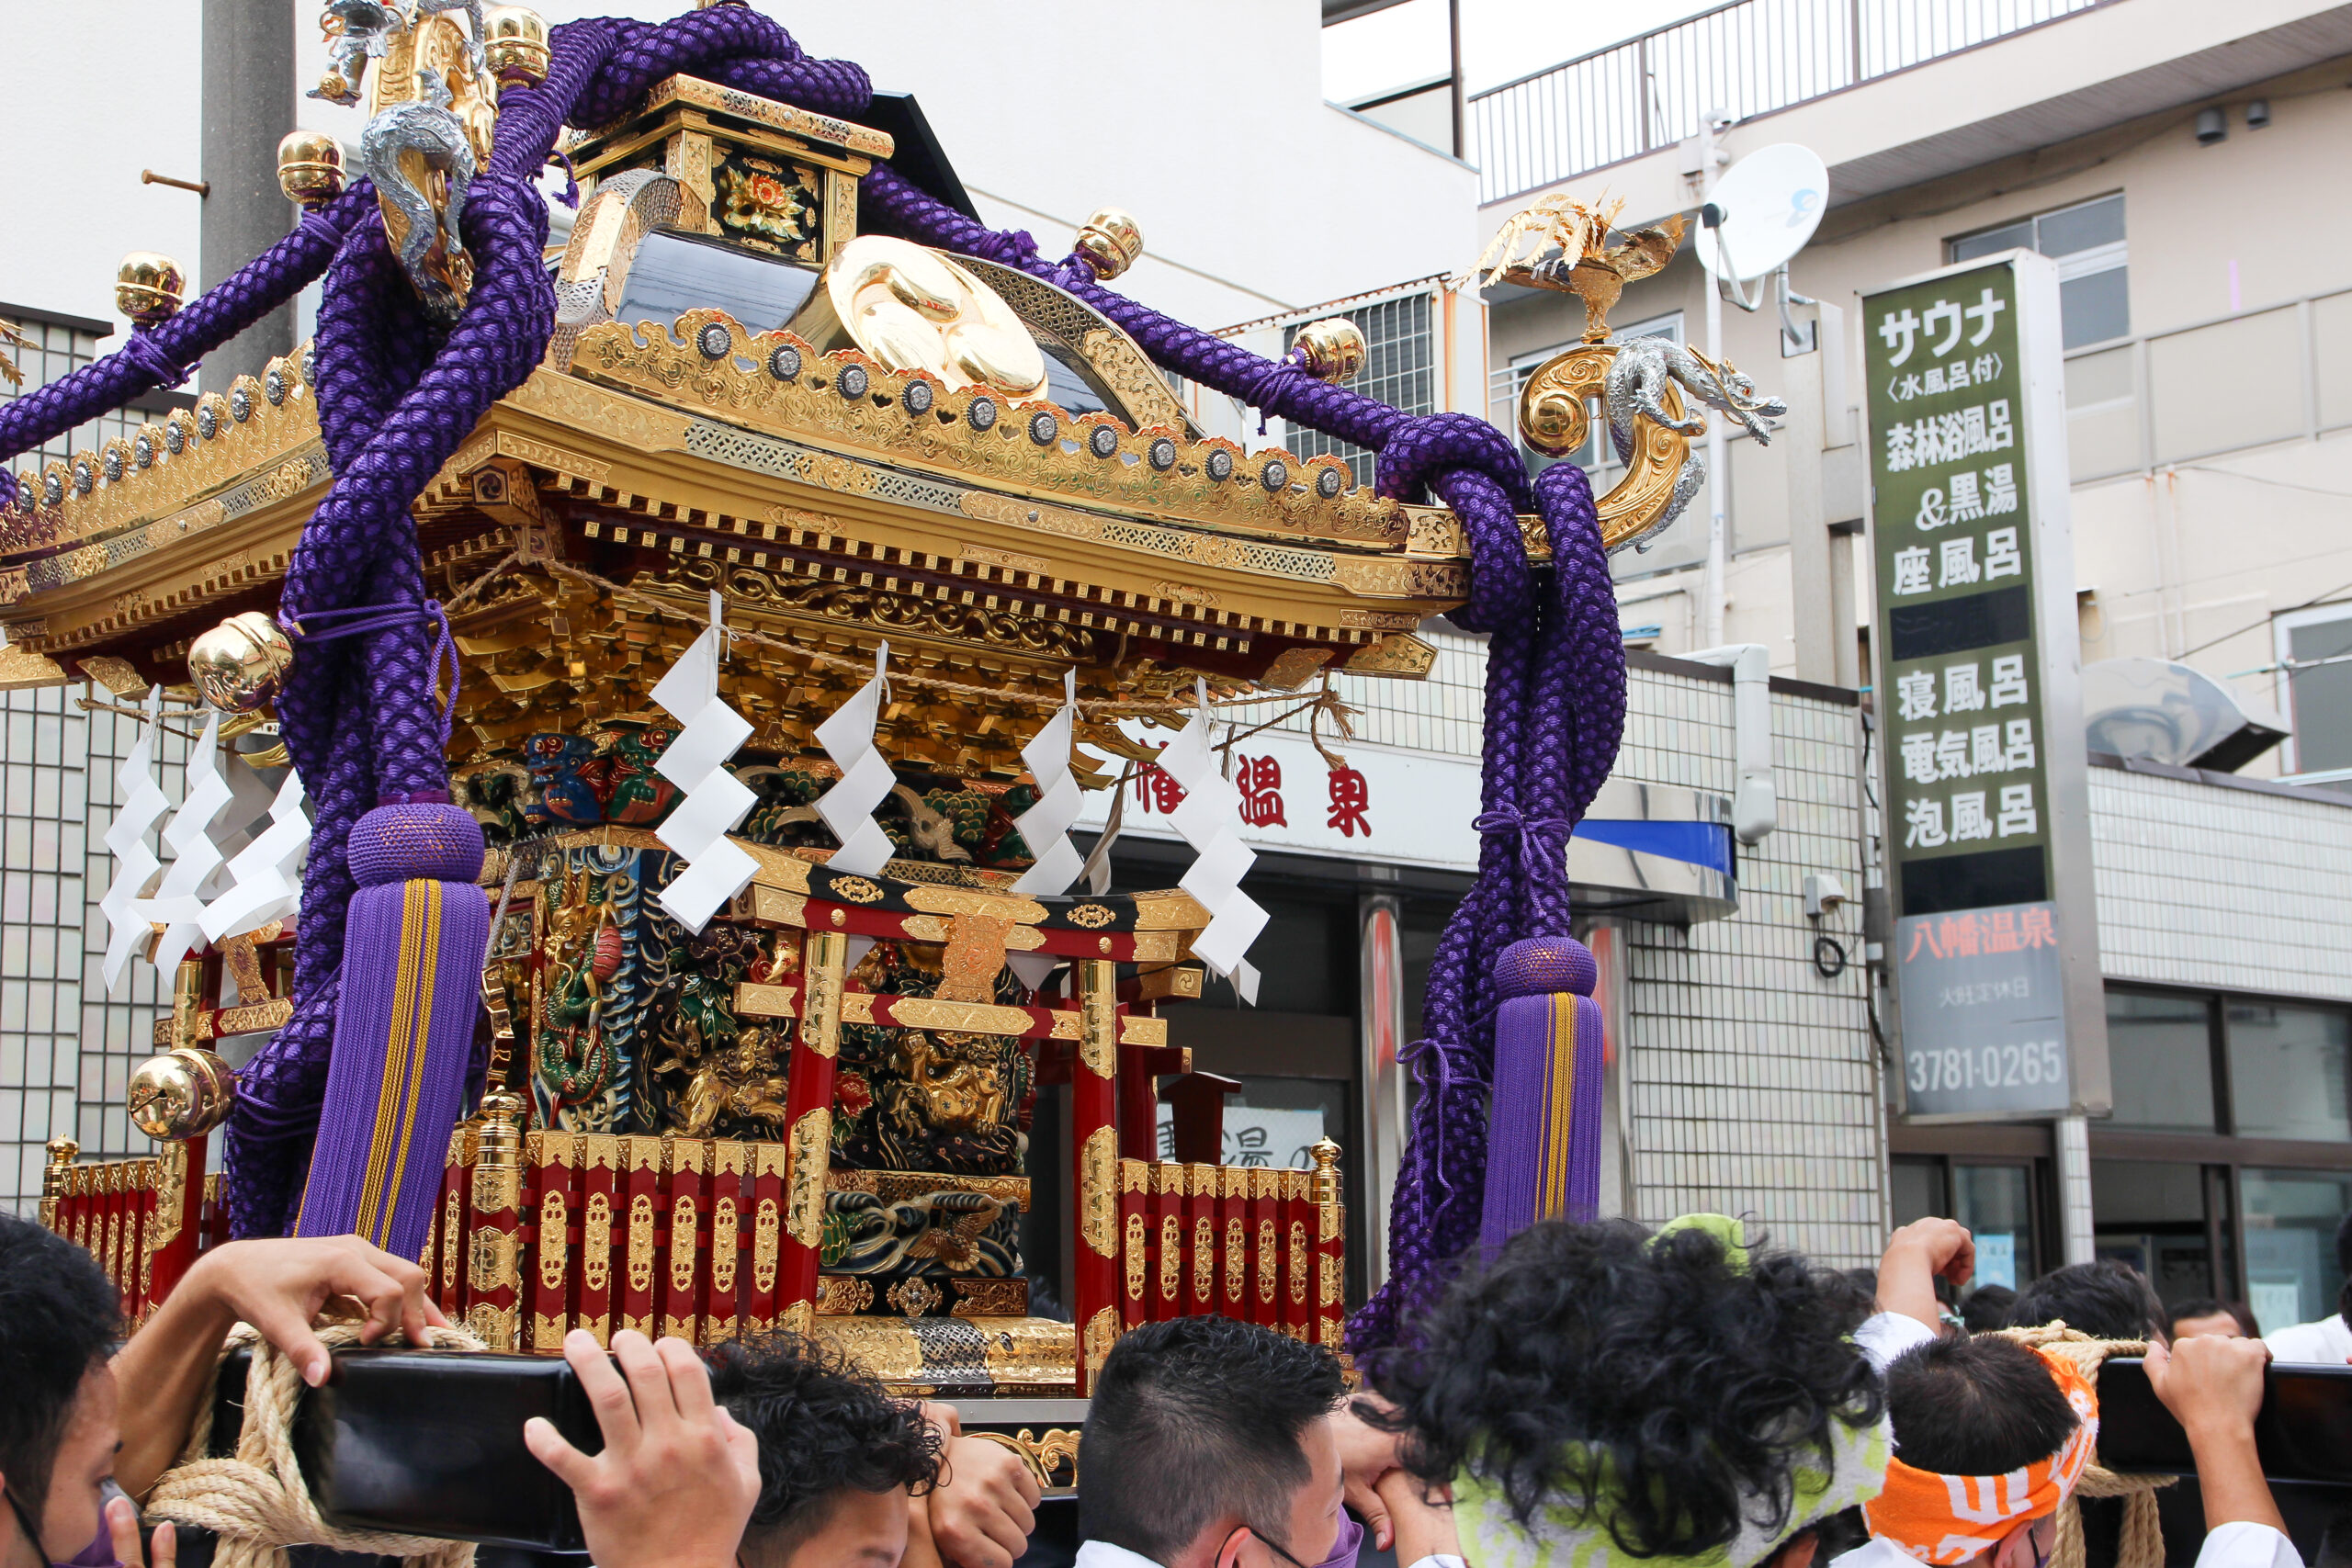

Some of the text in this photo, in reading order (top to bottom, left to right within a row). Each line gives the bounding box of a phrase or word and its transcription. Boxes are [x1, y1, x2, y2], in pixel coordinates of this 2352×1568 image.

[1879, 288, 2006, 367] サウナ
[1886, 399, 2014, 473] 森林浴風呂
[1916, 463, 2018, 531] &黒湯
[1893, 526, 2021, 595] 座風呂
[1896, 654, 2029, 721] 寝風呂
[1900, 718, 2036, 784] 電気風呂
[1905, 784, 2038, 849] 泡風呂
[1905, 907, 2058, 964] 八幡温泉
